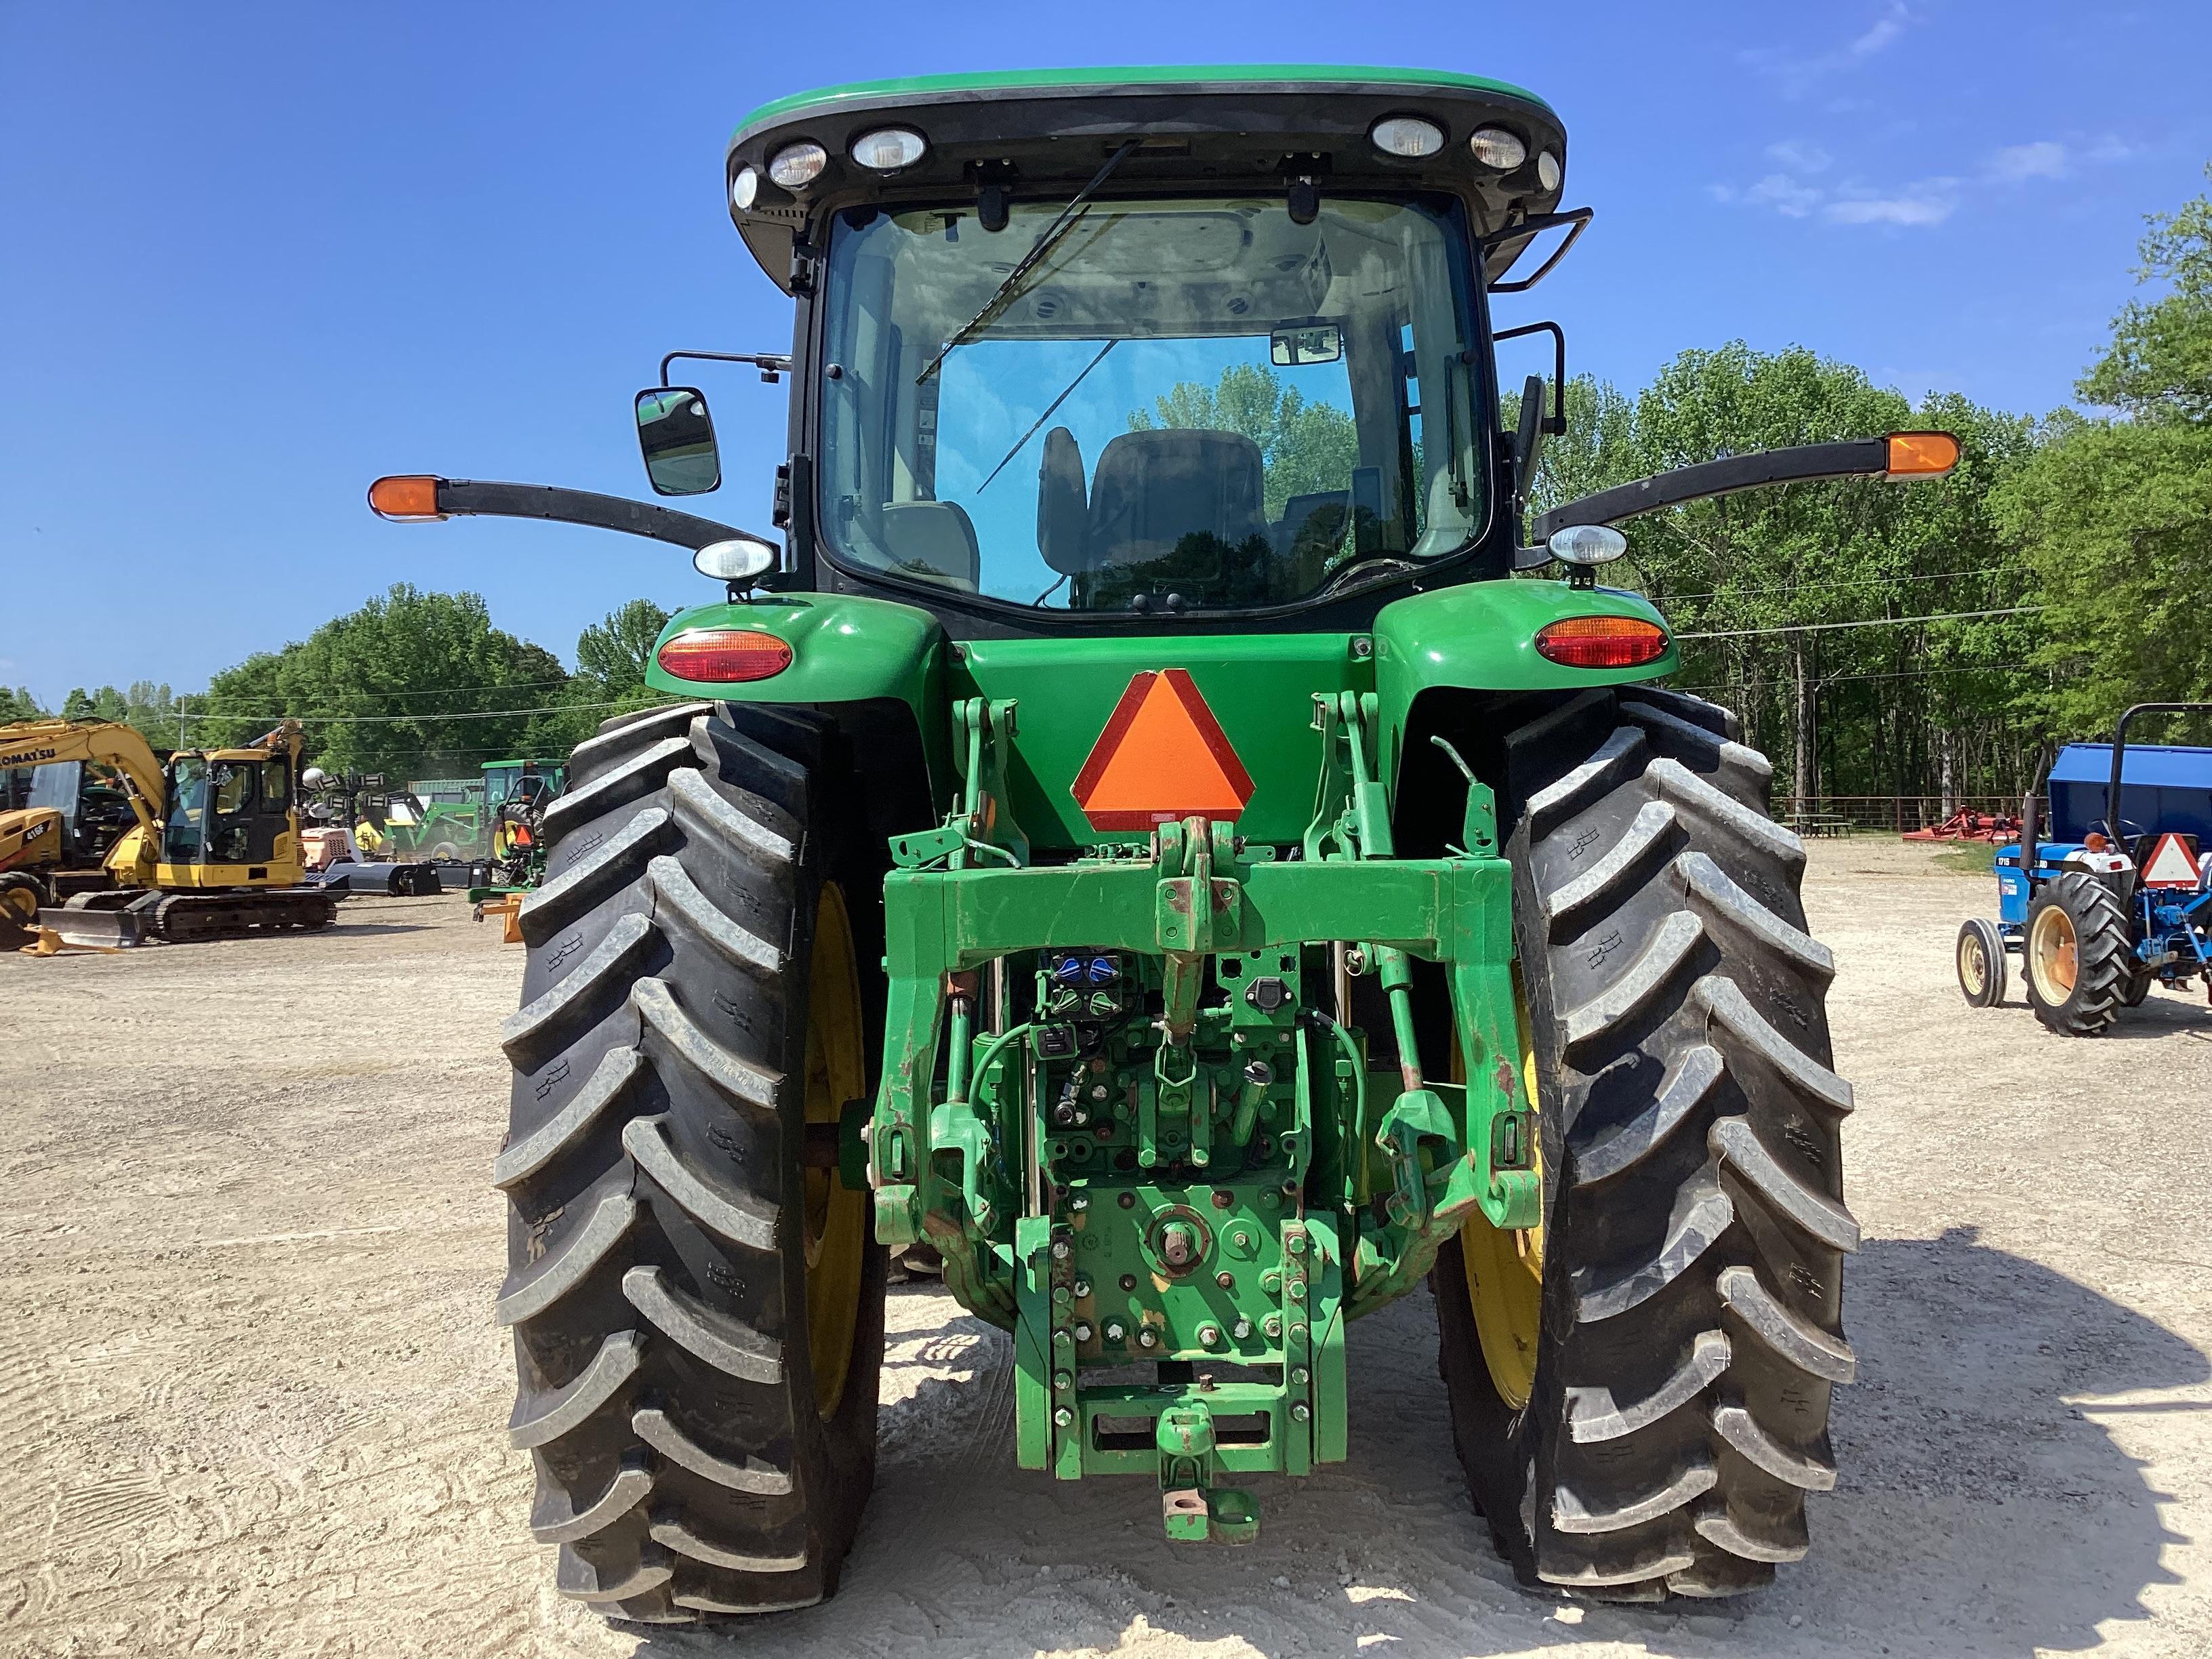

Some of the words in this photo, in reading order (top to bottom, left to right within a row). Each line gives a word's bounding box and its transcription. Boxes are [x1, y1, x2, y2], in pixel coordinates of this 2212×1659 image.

[0, 748, 56, 766] OMATSU
[27, 824, 44, 840] 416F
[1998, 857, 2010, 866] 1715
